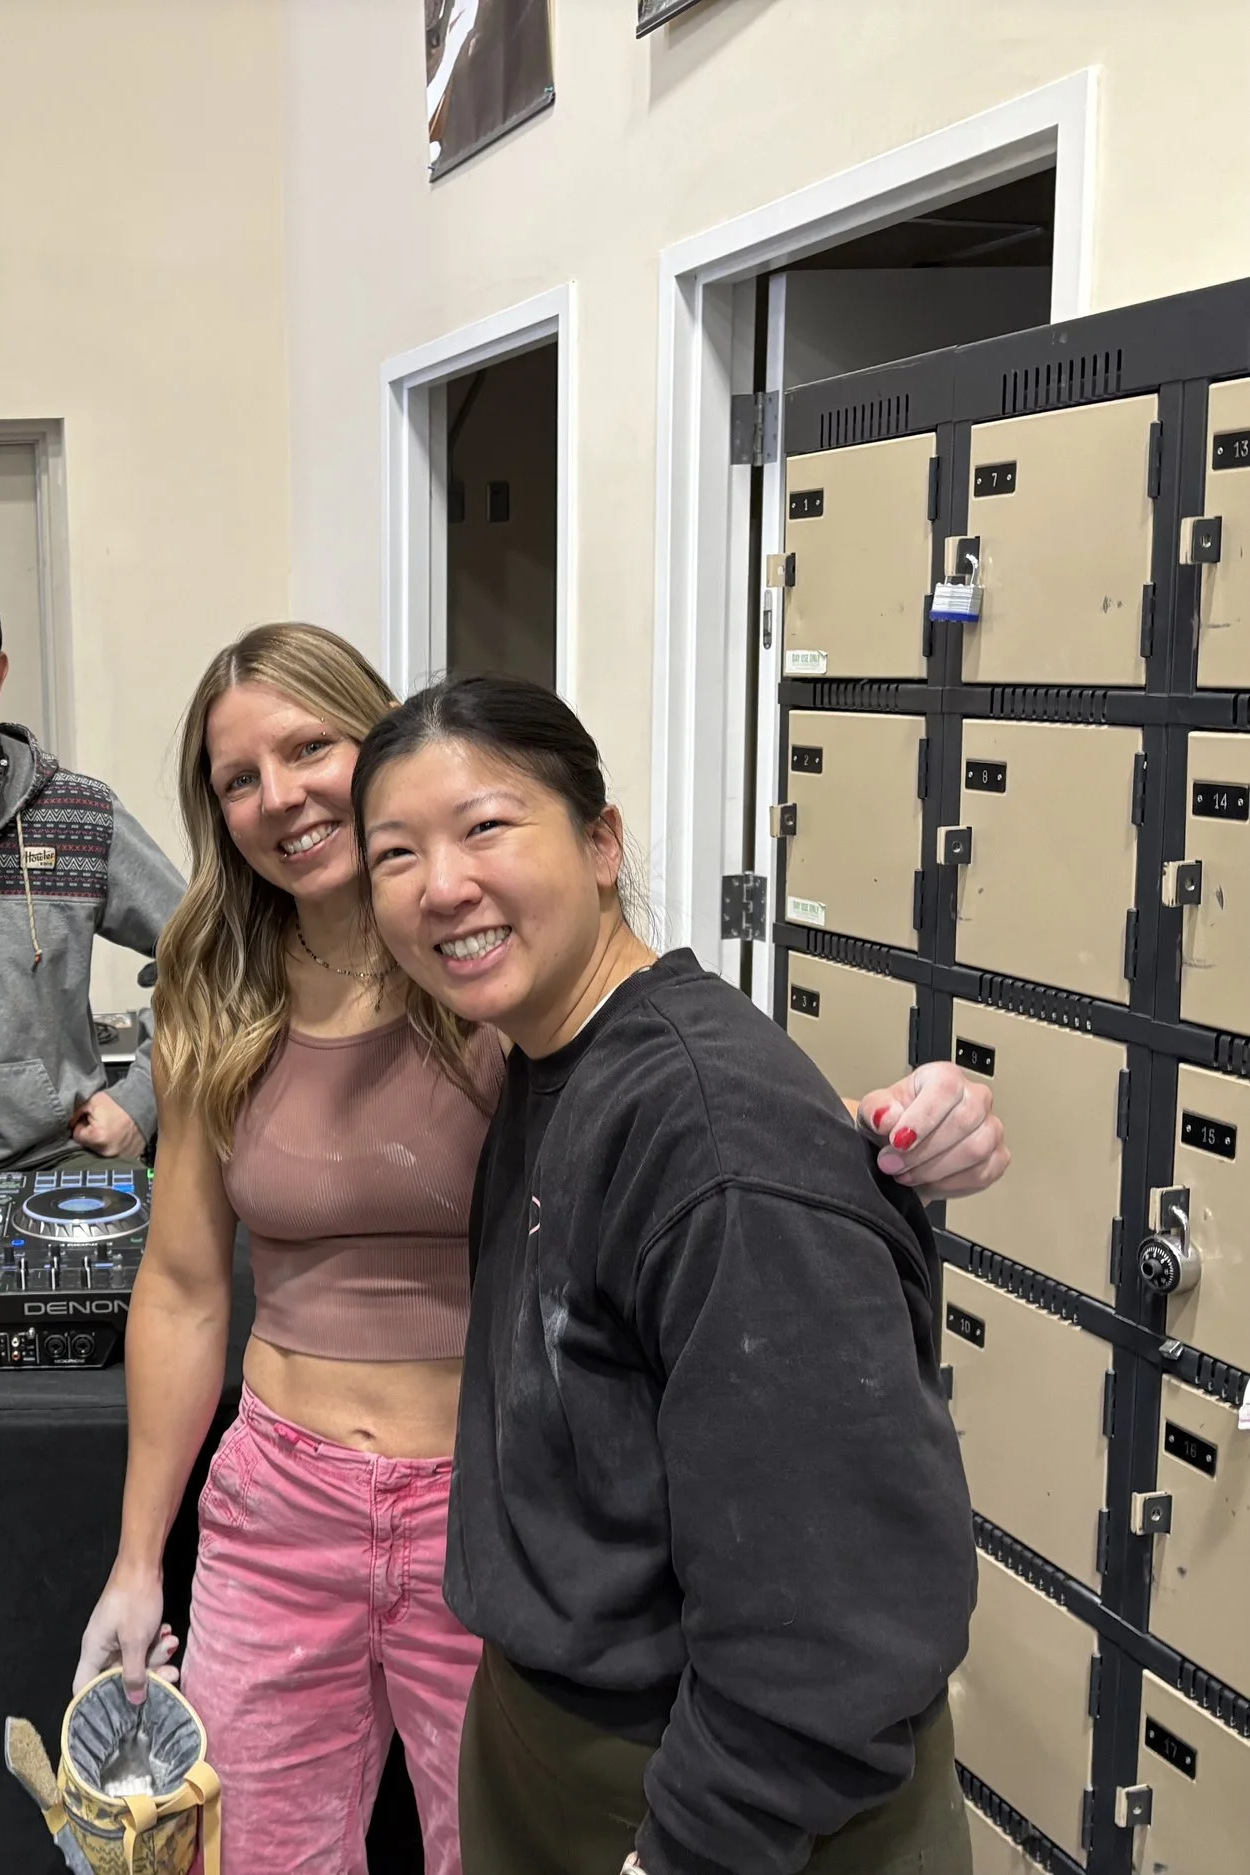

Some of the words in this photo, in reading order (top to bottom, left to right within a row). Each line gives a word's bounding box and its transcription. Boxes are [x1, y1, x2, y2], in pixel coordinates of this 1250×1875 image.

[1233, 440, 1249, 457] 13
[991, 473, 998, 487] 7
[804, 754, 809, 766] 2
[982, 770, 988, 783] 8
[1213, 793, 1227, 810] 14
[25, 850, 54, 863] Howler
[802, 995, 807, 1007] 3
[971, 1050, 977, 1064] 9
[1201, 1127, 1215, 1144] 15
[24, 1299, 129, 1315] DENON
[960, 1319, 971, 1333] 10
[1164, 1739, 1177, 1758] 17
